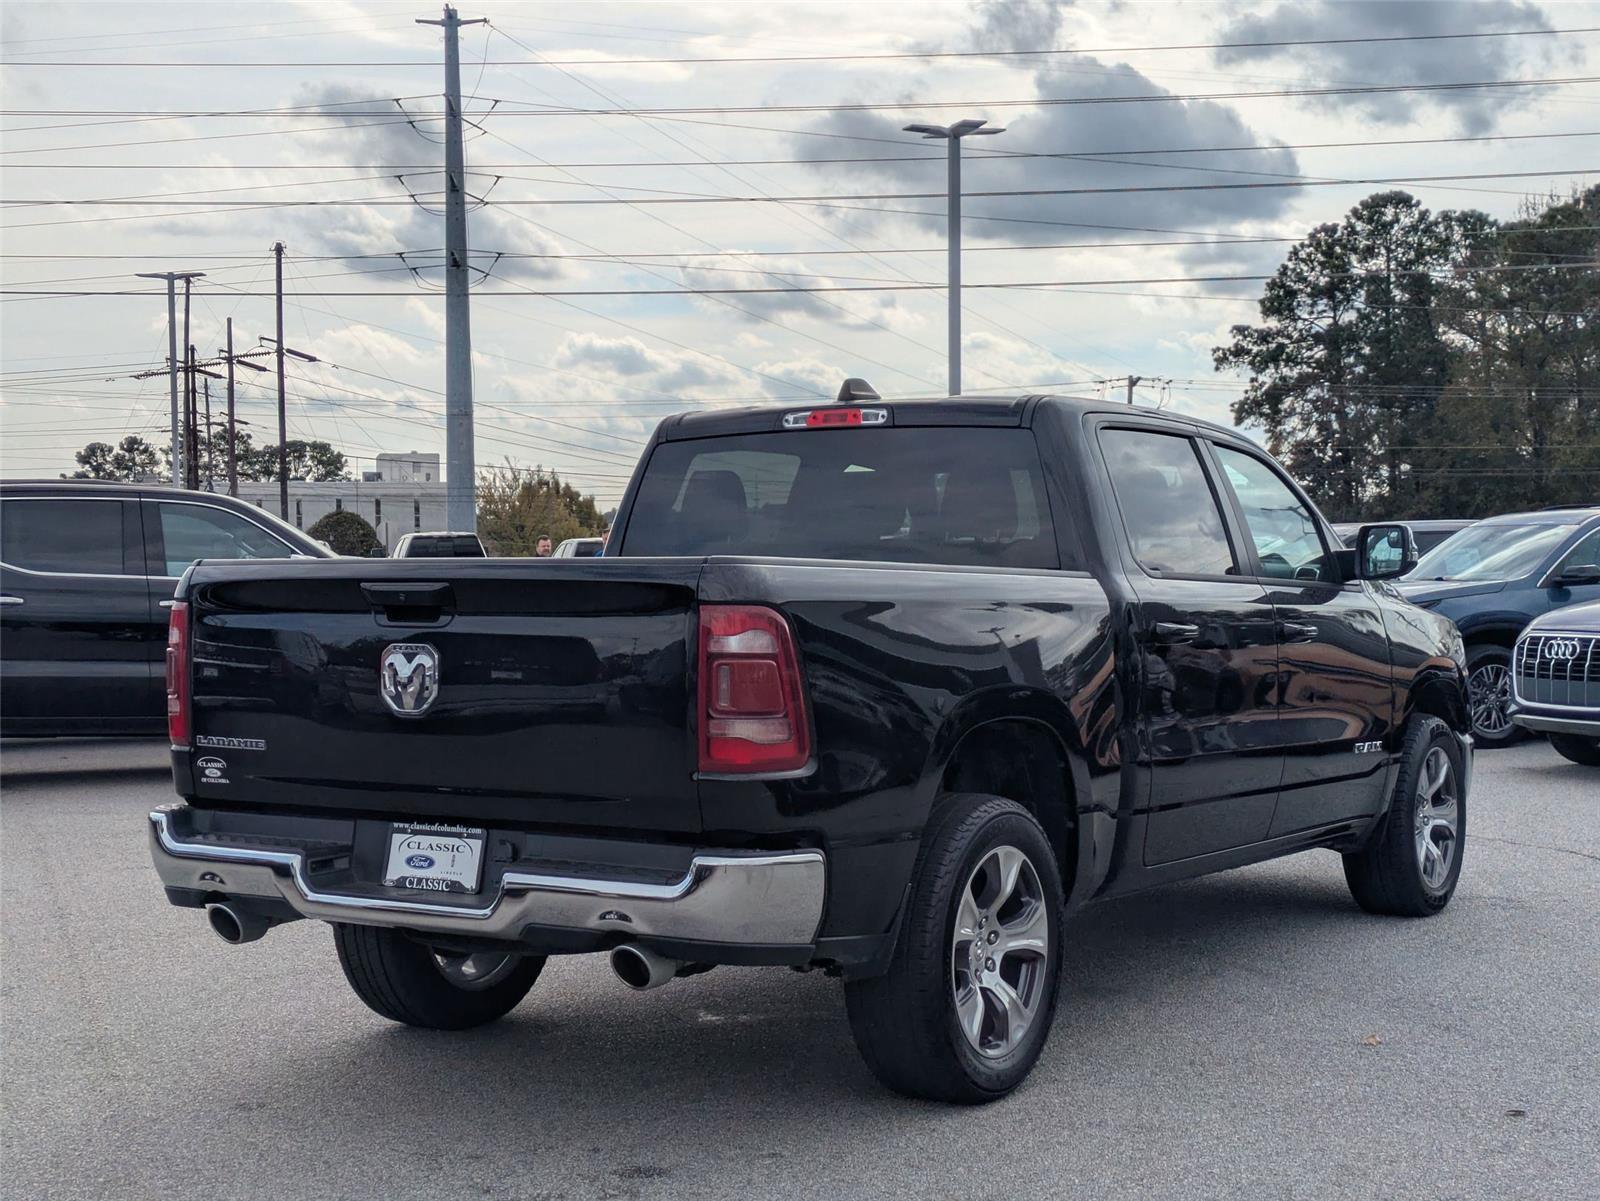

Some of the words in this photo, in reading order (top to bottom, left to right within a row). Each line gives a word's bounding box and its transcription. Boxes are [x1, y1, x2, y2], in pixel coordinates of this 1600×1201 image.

[196, 735, 265, 750] LARAMIE
[393, 822, 482, 834] www.classicofcolumbia.com
[407, 841, 466, 853] CLASSIC
[410, 856, 430, 867] Ford
[406, 877, 451, 891] CLASSIC
